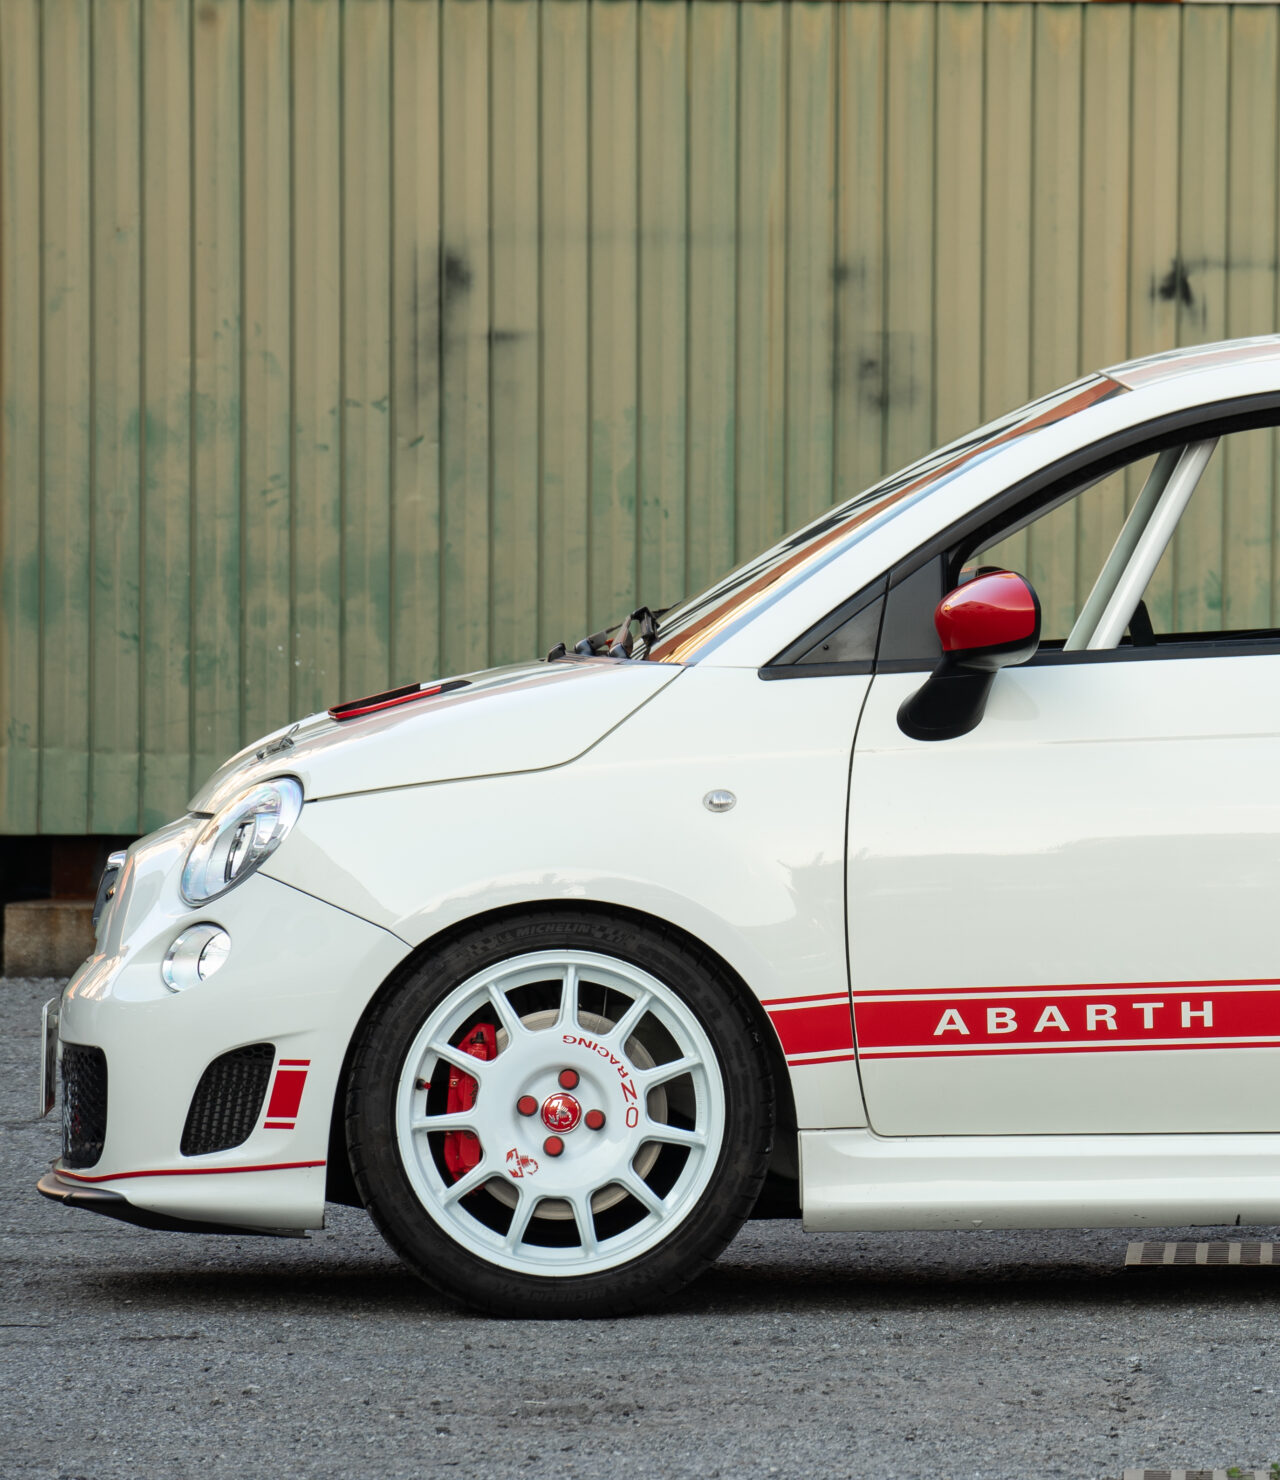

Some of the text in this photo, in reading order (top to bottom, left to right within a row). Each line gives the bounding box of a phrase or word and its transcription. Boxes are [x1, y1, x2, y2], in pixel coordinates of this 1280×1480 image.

[516, 921, 591, 937] MICHELIN
[933, 1001, 1214, 1036] ABARTH
[563, 1034, 628, 1079] RACING
